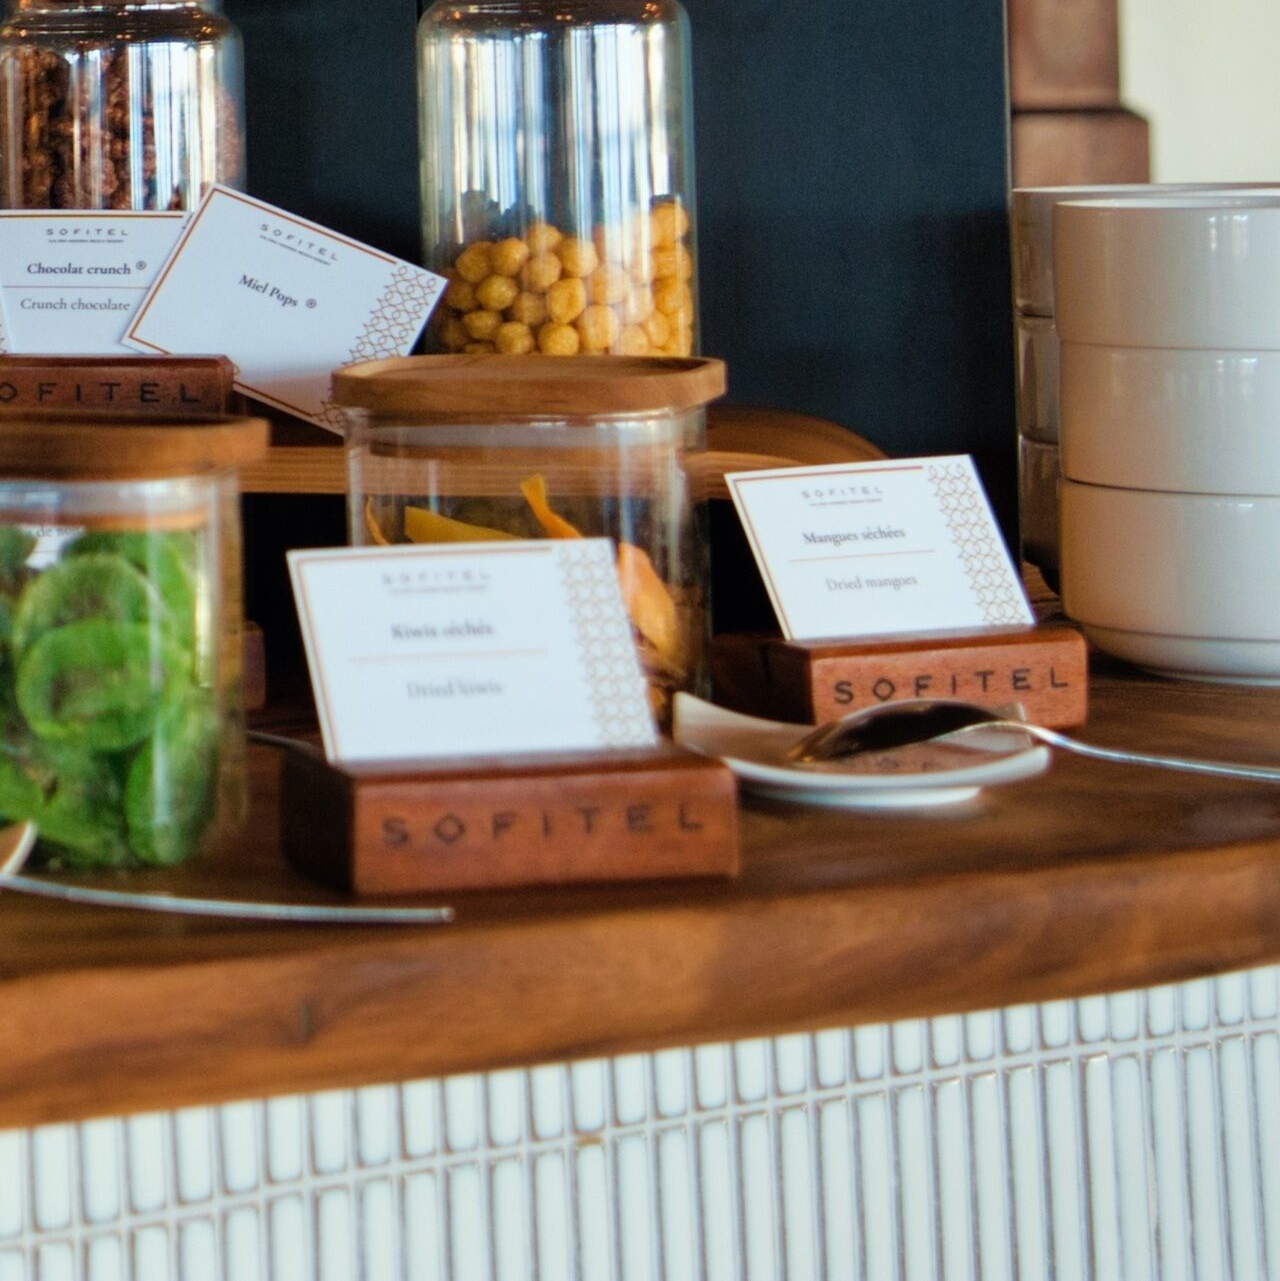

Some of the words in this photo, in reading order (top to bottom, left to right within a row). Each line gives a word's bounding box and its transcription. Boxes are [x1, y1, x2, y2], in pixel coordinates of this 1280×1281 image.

[46, 228, 129, 236] SOFITEL
[259, 223, 338, 261] SOFITEL
[27, 261, 83, 275] Chocolat
[86, 262, 132, 275] crunch
[239, 273, 270, 294] Miel
[269, 286, 299, 308] Pops
[20, 297, 68, 310] Crunch
[70, 298, 131, 311] chocolate
[801, 486, 884, 499] SOFITEL
[802, 531, 859, 547] Mangues
[860, 524, 906, 540] séchées
[825, 575, 862, 592] Dried
[835, 667, 1069, 705] SOFITEL
[382, 804, 705, 850] SOFITEL
